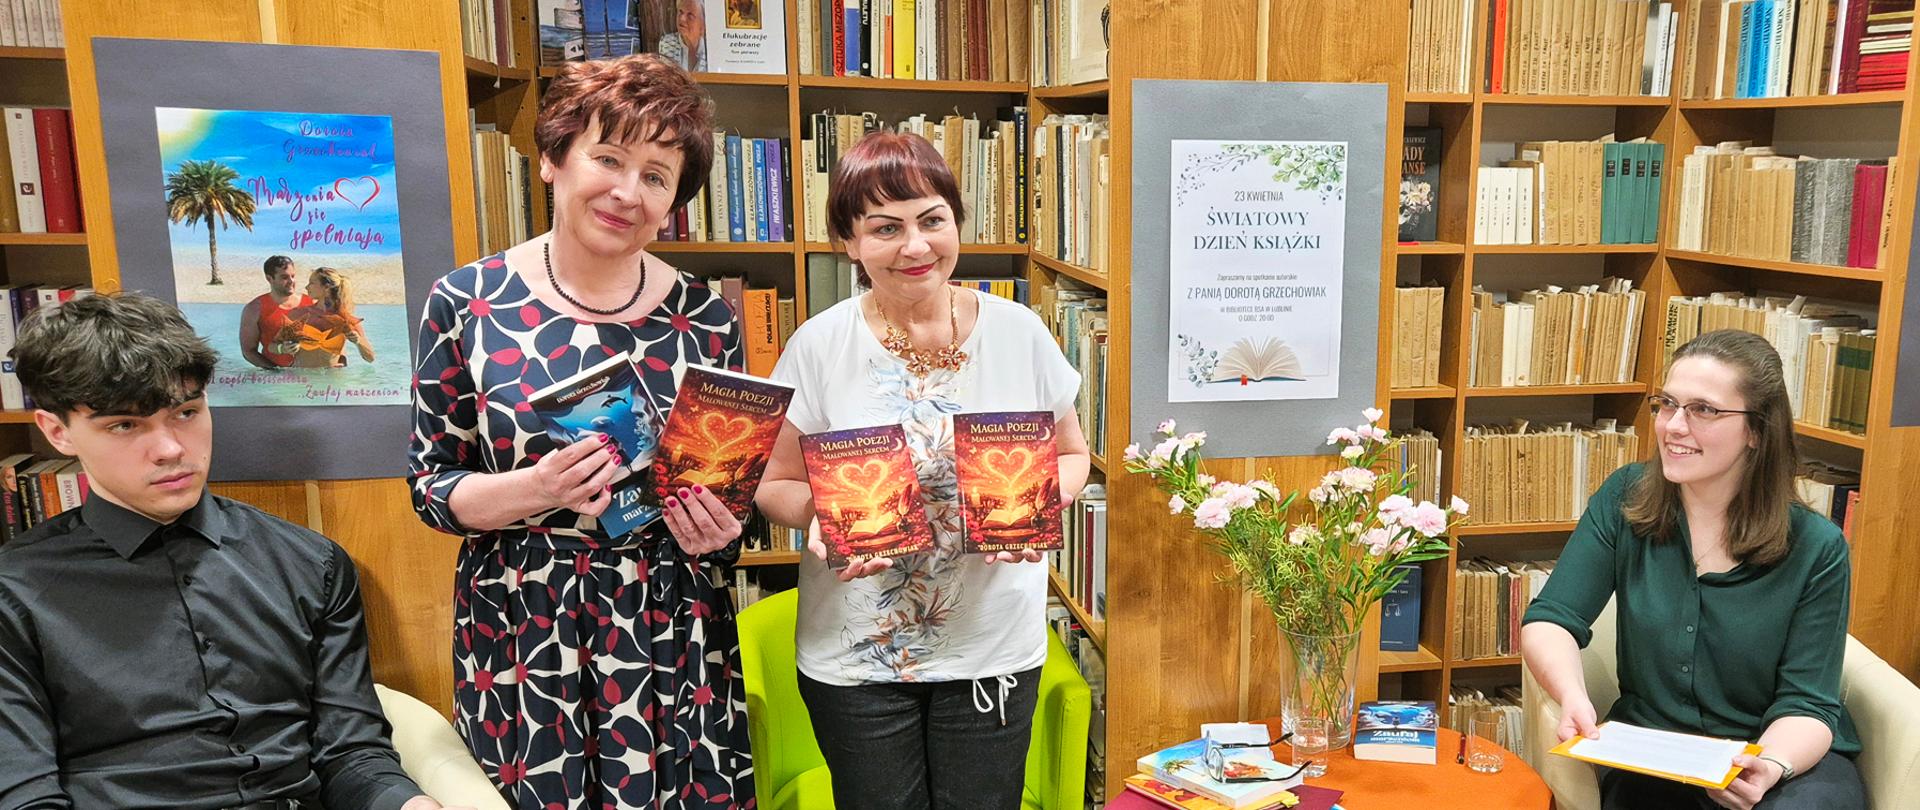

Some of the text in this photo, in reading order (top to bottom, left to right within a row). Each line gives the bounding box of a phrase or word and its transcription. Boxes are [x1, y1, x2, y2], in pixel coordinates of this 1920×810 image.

[1764, 8, 1772, 43] NORWID
[1776, 8, 1784, 44] NORWID
[722, 32, 768, 41] Elukubracje
[248, 176, 336, 221] Marzenia
[770, 168, 780, 224] IWASZKIEWICZ
[1234, 190, 1284, 201] 23 KWIETNIA
[1206, 206, 1309, 226] ŚWIATOWY
[1194, 230, 1320, 253] DZIEŃ KSIĄŻKI
[1217, 273, 1245, 281] Zapraszamy
[1187, 286, 1327, 301] Z PANIĄ DOROTĄ GRZECHOWIAK
[700, 382, 774, 406] MAGIA POEZJI
[697, 395, 767, 414] MALOWANEJ SERCEM
[970, 422, 1039, 434] MAGIA POEZJI
[820, 435, 890, 452] MAGIA POEZJI
[823, 446, 890, 460] MALOWANEJ SERCEM
[875, 545, 919, 557] GRZECHOWIAK
